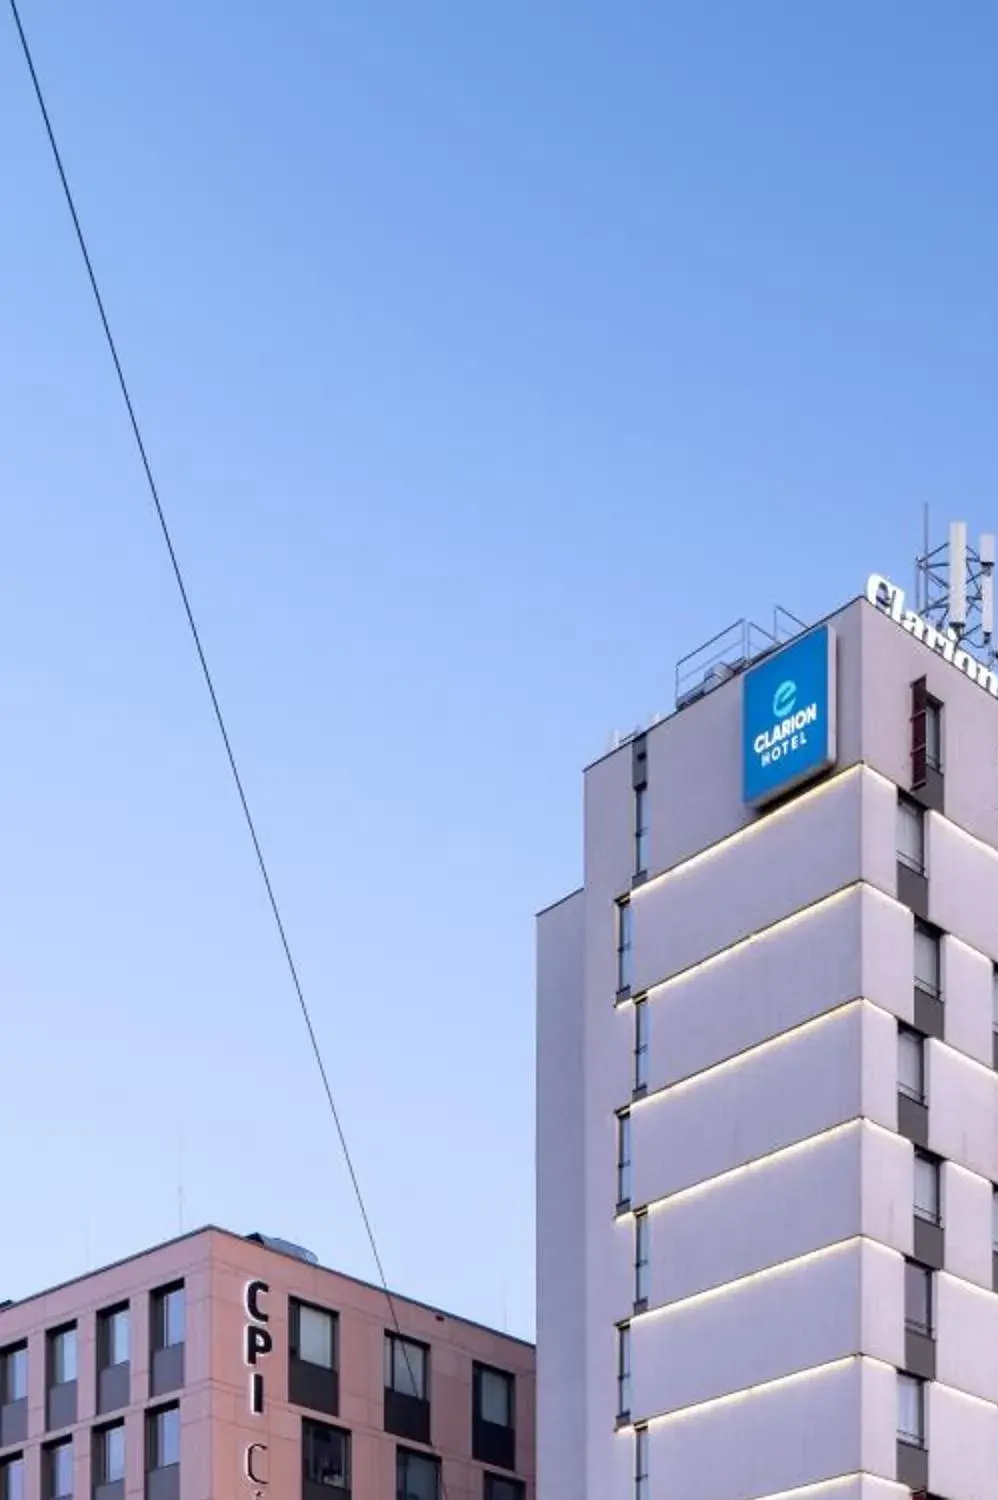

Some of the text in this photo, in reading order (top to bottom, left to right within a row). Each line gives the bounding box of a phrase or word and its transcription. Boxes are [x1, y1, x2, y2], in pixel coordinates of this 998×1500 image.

[753, 701, 818, 754] CLARION
[760, 730, 808, 768] HOTEL
[244, 1279, 273, 1414] CPI
